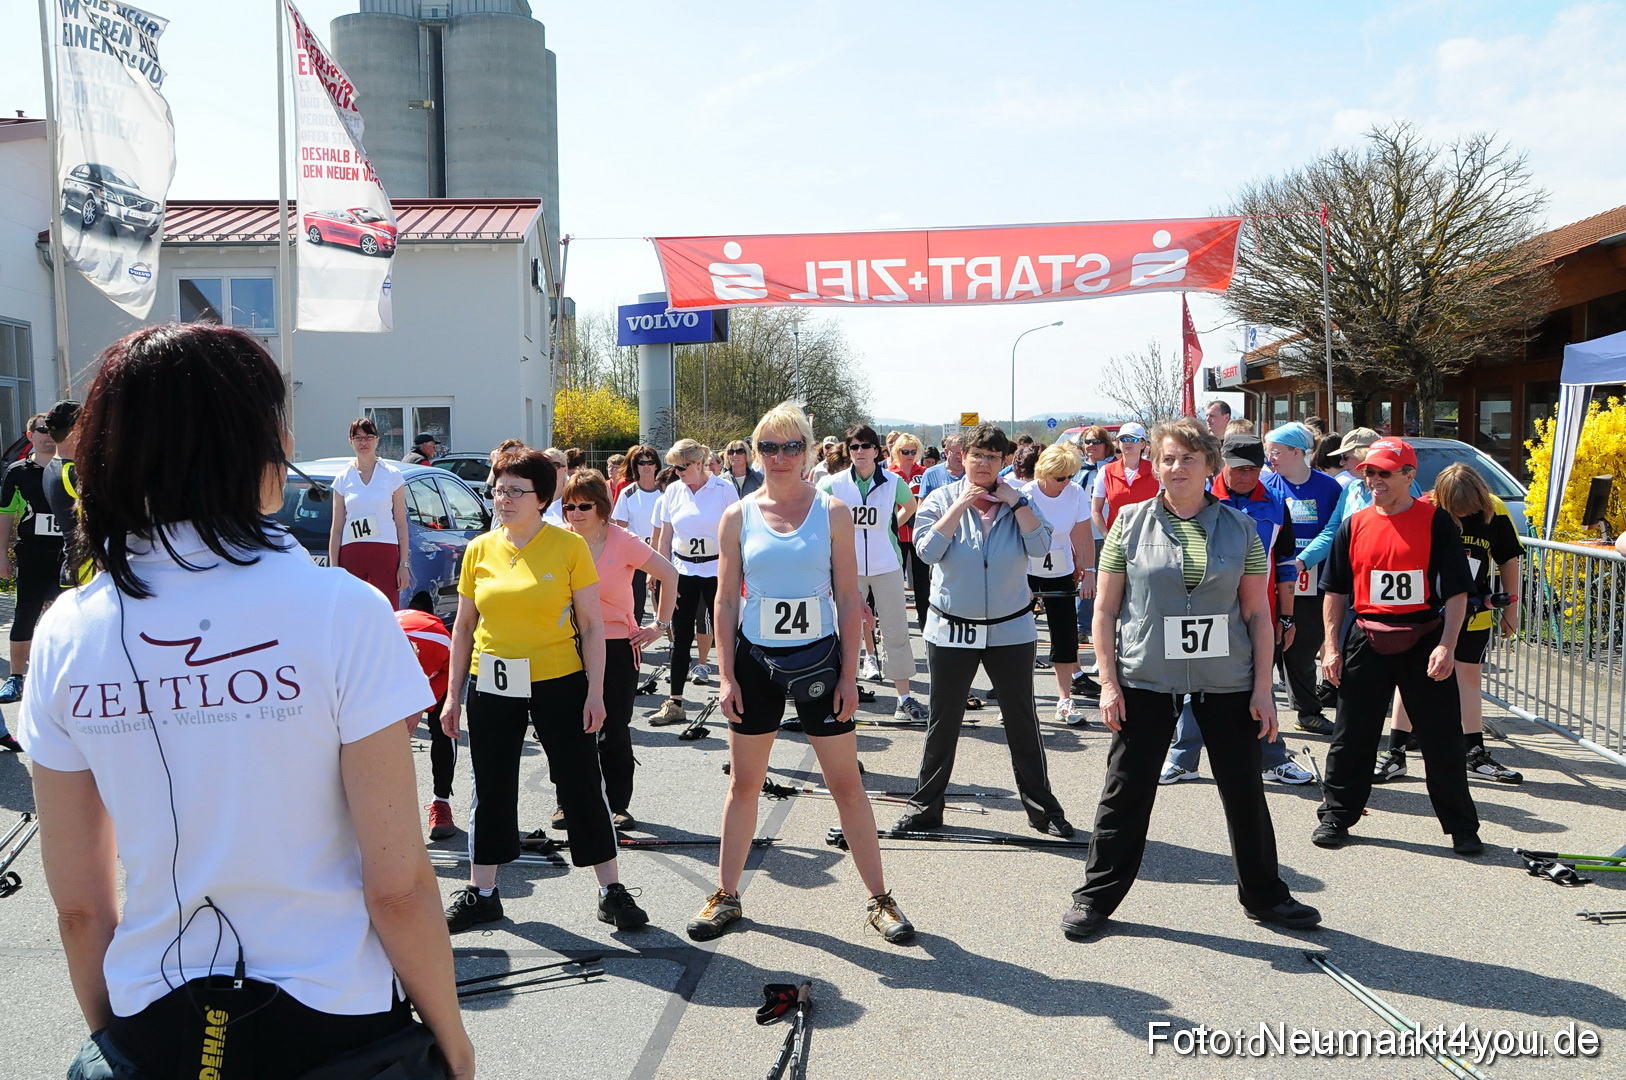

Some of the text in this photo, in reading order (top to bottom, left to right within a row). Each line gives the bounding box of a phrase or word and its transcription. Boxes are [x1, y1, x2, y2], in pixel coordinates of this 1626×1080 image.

[302, 147, 350, 163] DESHALB
[303, 165, 323, 178] DEN
[327, 165, 359, 181] NEUEN
[626, 312, 699, 331] VOLVO
[1223, 365, 1238, 379] SEAT
[852, 506, 878, 526] 120
[350, 520, 371, 538] 114
[689, 537, 706, 555] 21
[1380, 572, 1412, 600] 28
[774, 601, 810, 634] 24
[948, 621, 977, 645] 116
[1181, 618, 1214, 653] 57
[493, 659, 508, 691] 6
[69, 665, 301, 719] ZEITLOS
[174, 709, 238, 726] Wellness
[258, 703, 304, 722] Figur
